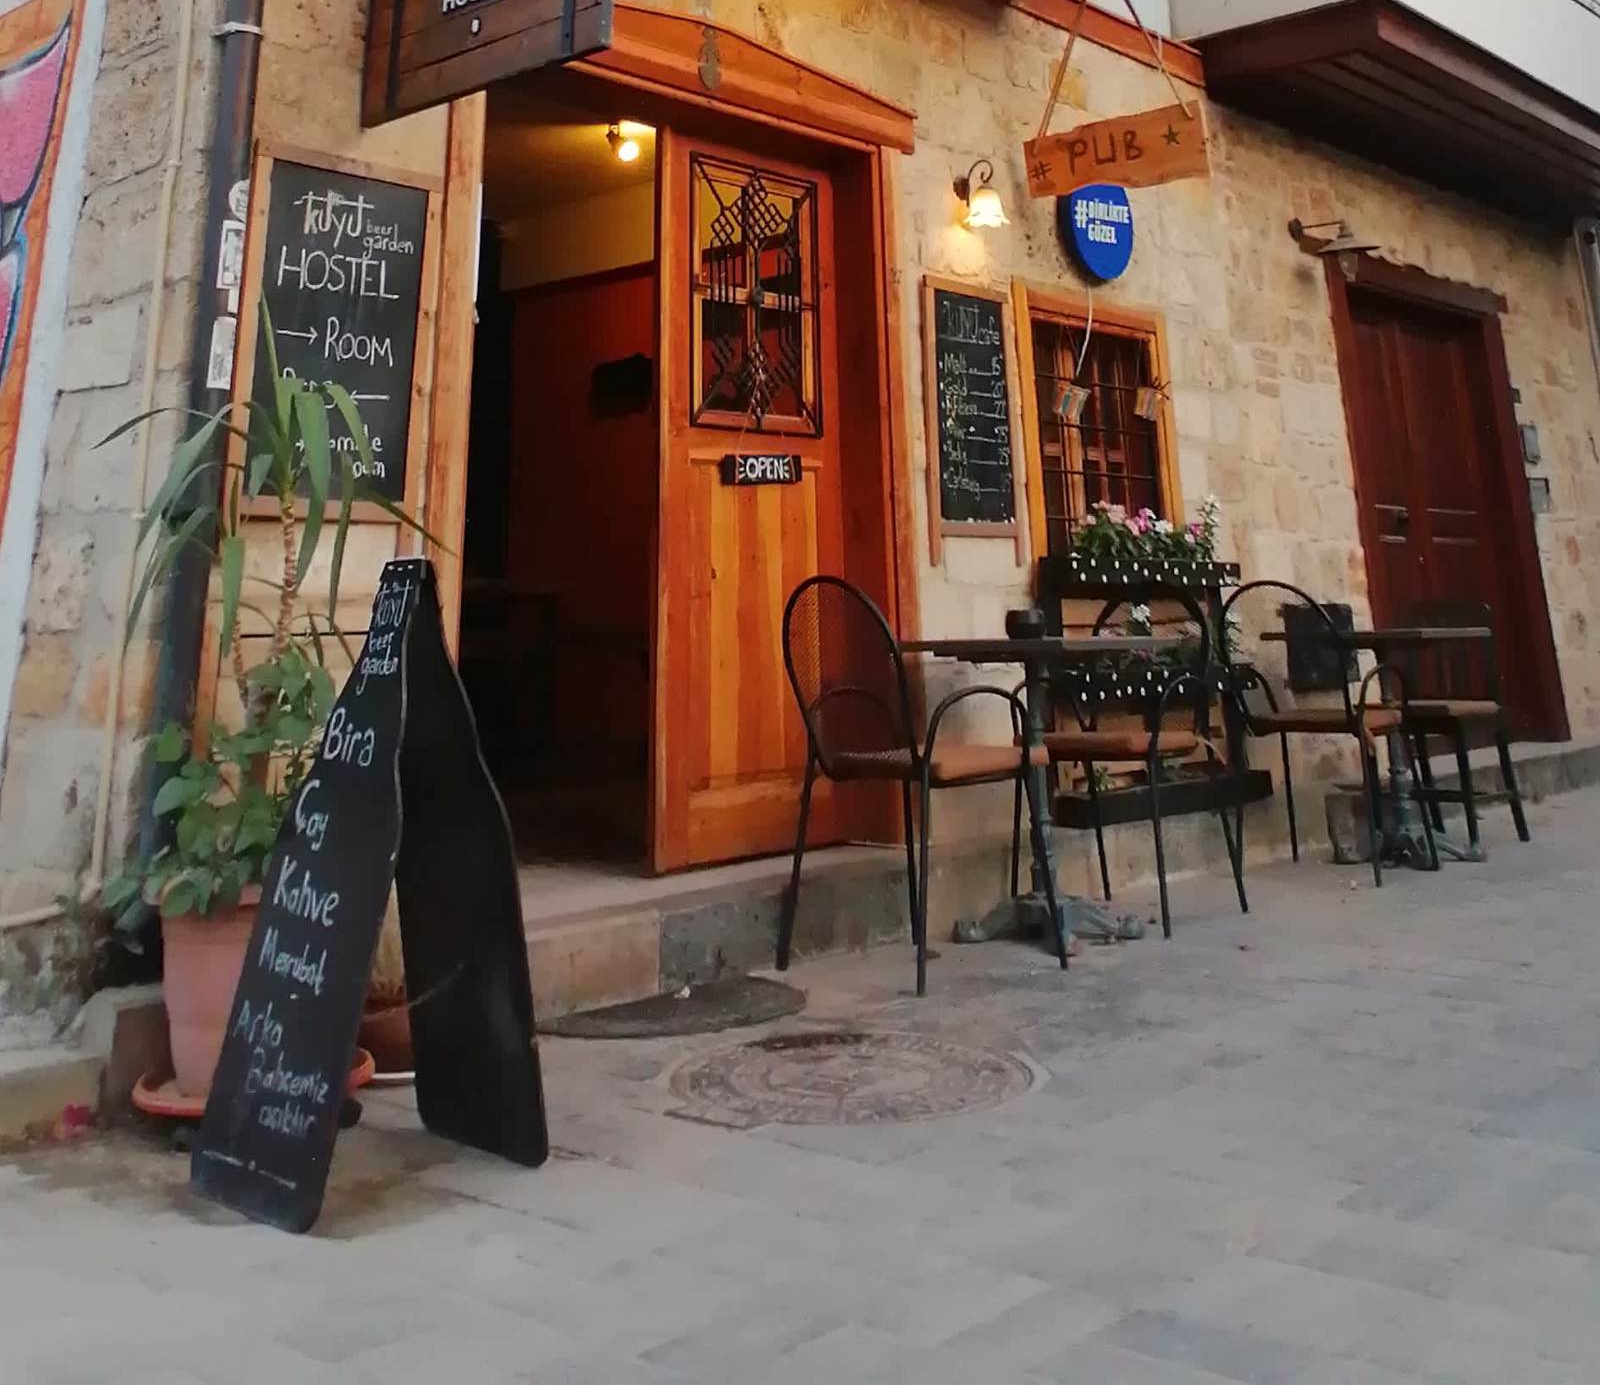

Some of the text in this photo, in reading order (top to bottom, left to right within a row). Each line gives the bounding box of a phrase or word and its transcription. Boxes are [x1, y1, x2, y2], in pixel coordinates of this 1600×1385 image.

[1060, 129, 1144, 175] PUB
[362, 223, 415, 259] garden
[366, 219, 393, 236] beer
[1087, 220, 1118, 245] GÜZEL
[276, 245, 400, 300] HOSTEL
[324, 316, 394, 367] ROOM
[746, 457, 785, 480] OPEN
[356, 645, 399, 695] garden
[323, 707, 376, 767] Bira
[273, 855, 340, 927] Kahve
